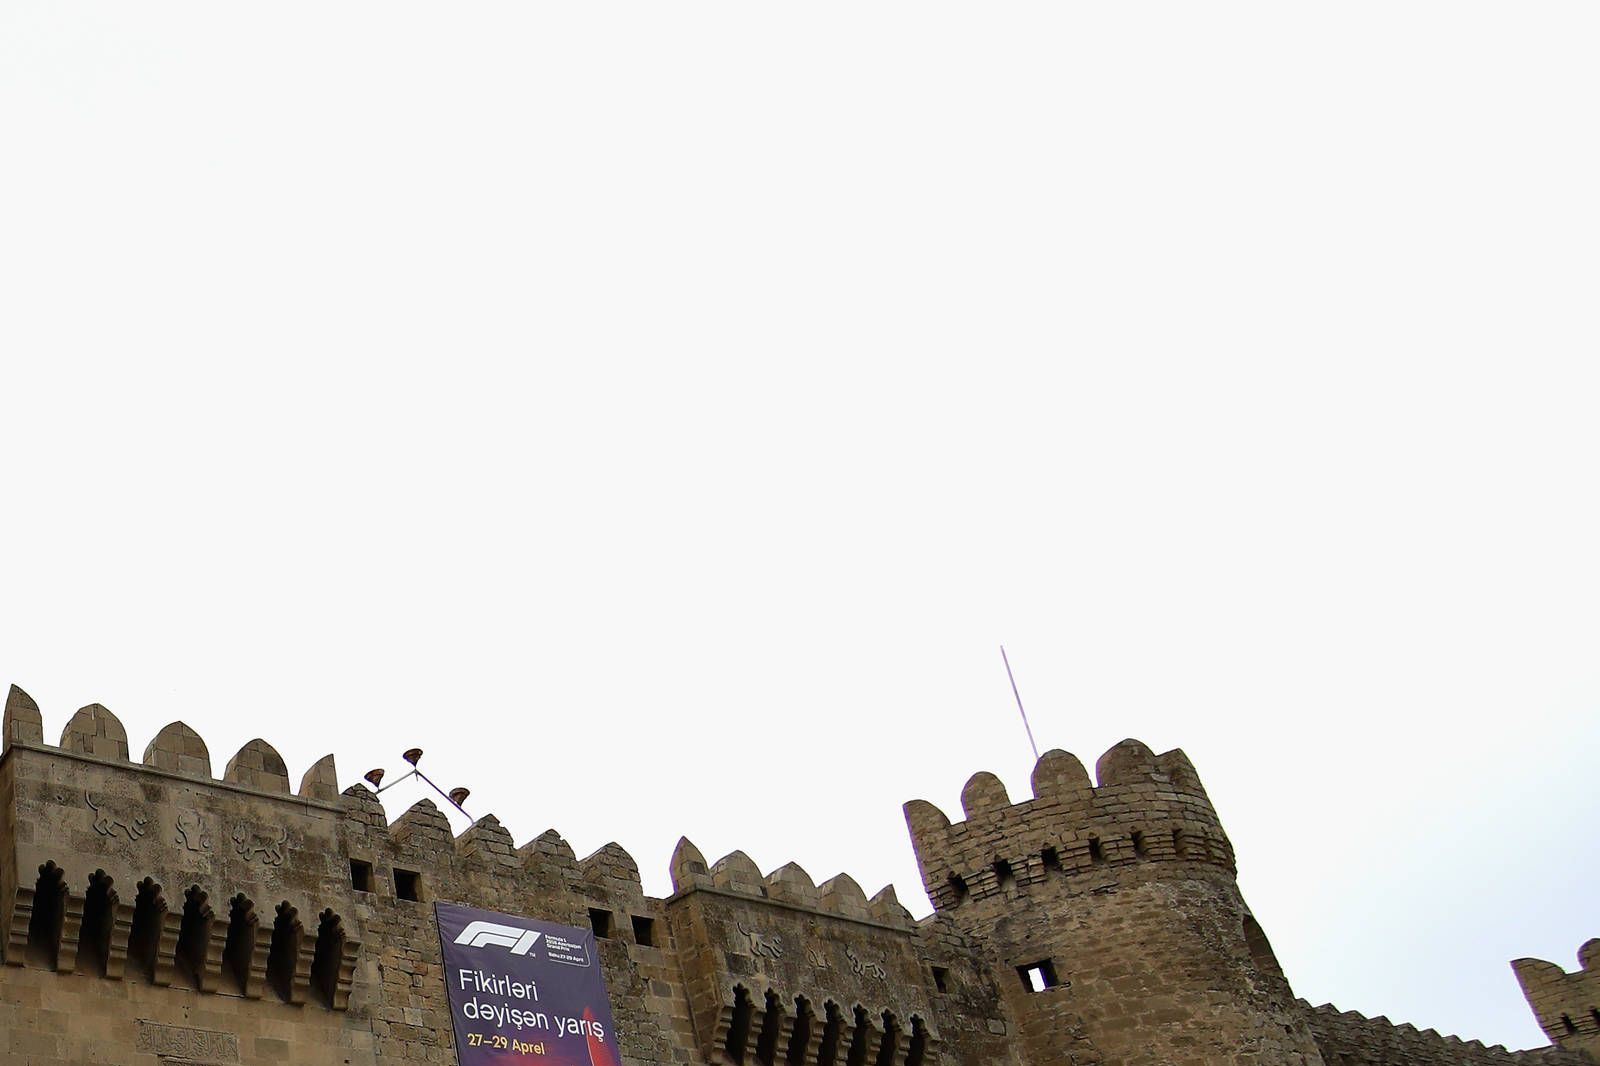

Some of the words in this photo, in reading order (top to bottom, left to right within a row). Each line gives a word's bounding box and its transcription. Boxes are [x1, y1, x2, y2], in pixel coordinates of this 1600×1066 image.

[459, 968, 539, 1001] Fikirləri
[463, 997, 549, 1031] dəyişən
[554, 1015, 605, 1043] yarış
[512, 1038, 546, 1055] Aprel
